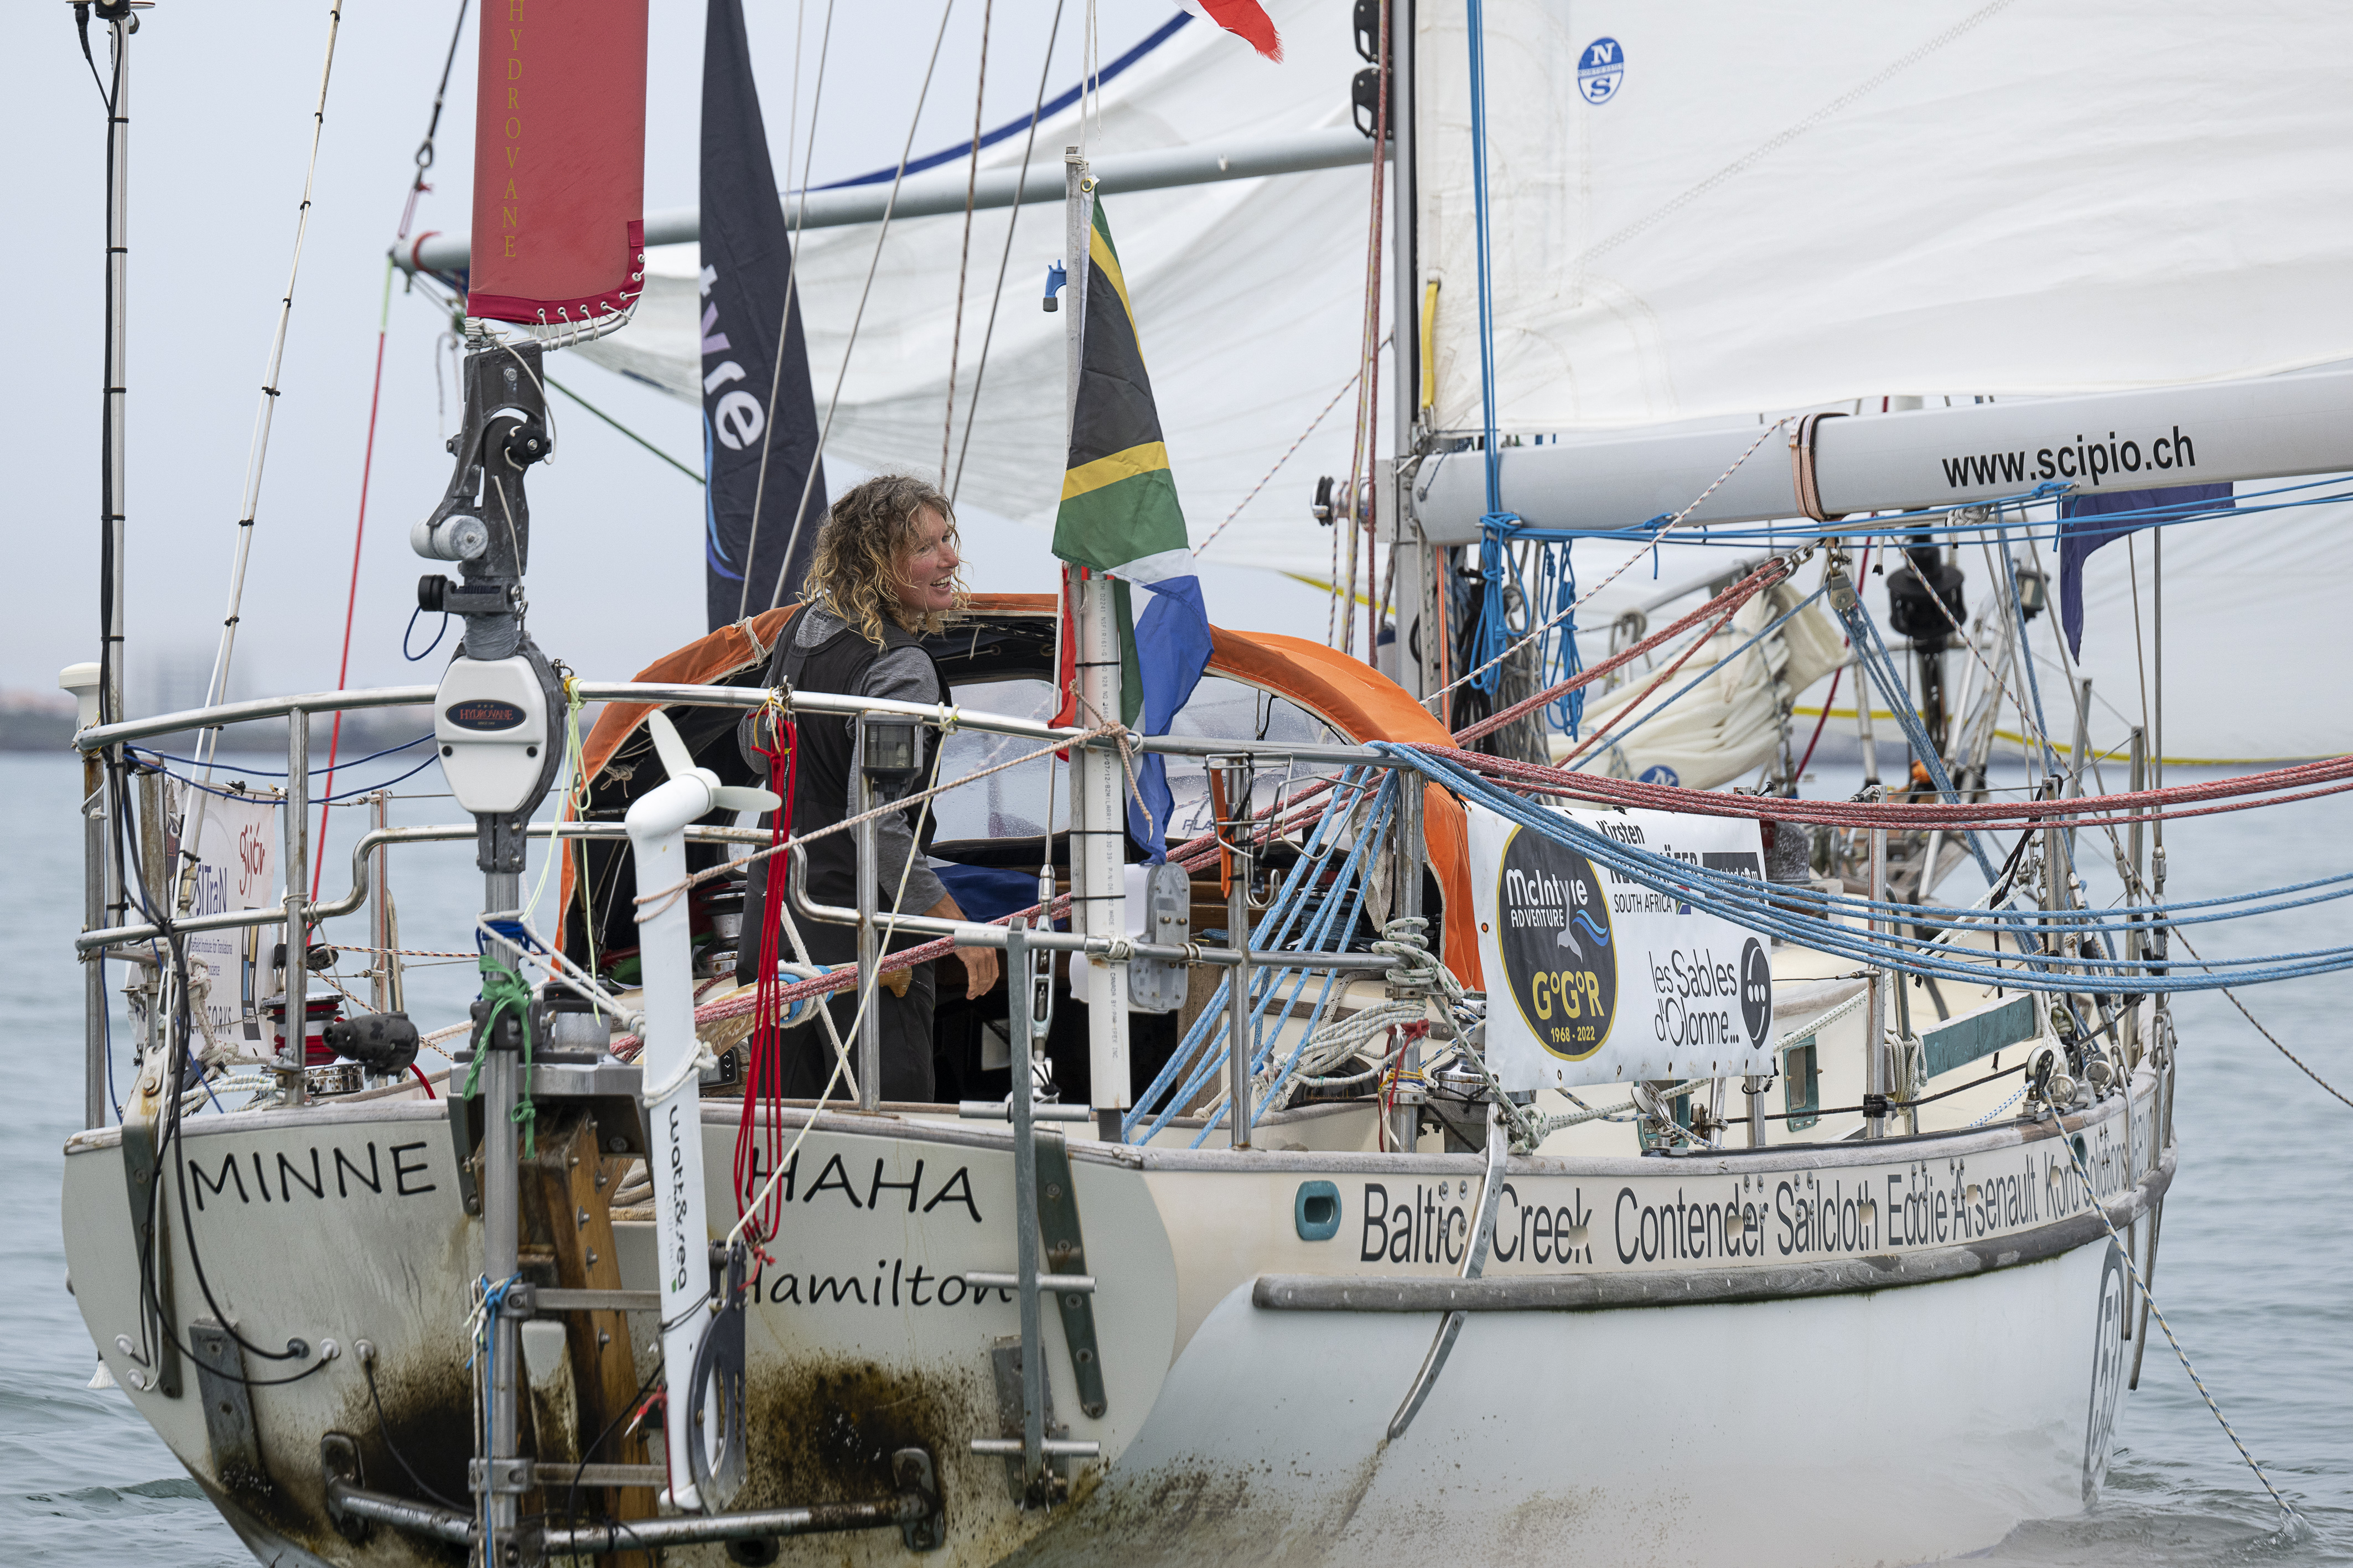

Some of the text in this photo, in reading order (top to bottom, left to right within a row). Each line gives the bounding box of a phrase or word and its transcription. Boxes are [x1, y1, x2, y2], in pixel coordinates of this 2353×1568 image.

[1590, 41, 1615, 66] N
[1590, 77, 1610, 97] S
[502, 0, 525, 257] HYDROVANE
[1942, 425, 2195, 487] www.scipio.ch
[460, 709, 514, 720] HYDROVANE
[1596, 820, 1645, 844] Kirsten
[1506, 869, 1588, 906] McIntyre
[1614, 892, 1672, 913] SOUTH AFRICA
[1511, 908, 1564, 927] ADVENTURE
[1649, 948, 1737, 998] les Sables
[1551, 1027, 1571, 1042] 1968
[1577, 1026, 1595, 1042] 2022
[188, 1141, 982, 1222] MINNE HAHA
[1360, 1183, 1465, 1265] Baltic
[1495, 1182, 1593, 1265] Creek
[1615, 1182, 1769, 1265] Contender
[1776, 1180, 1878, 1256] Sailcloth
[1888, 1173, 1947, 1247] Eddie
[1953, 1154, 2039, 1241] Arsenault
